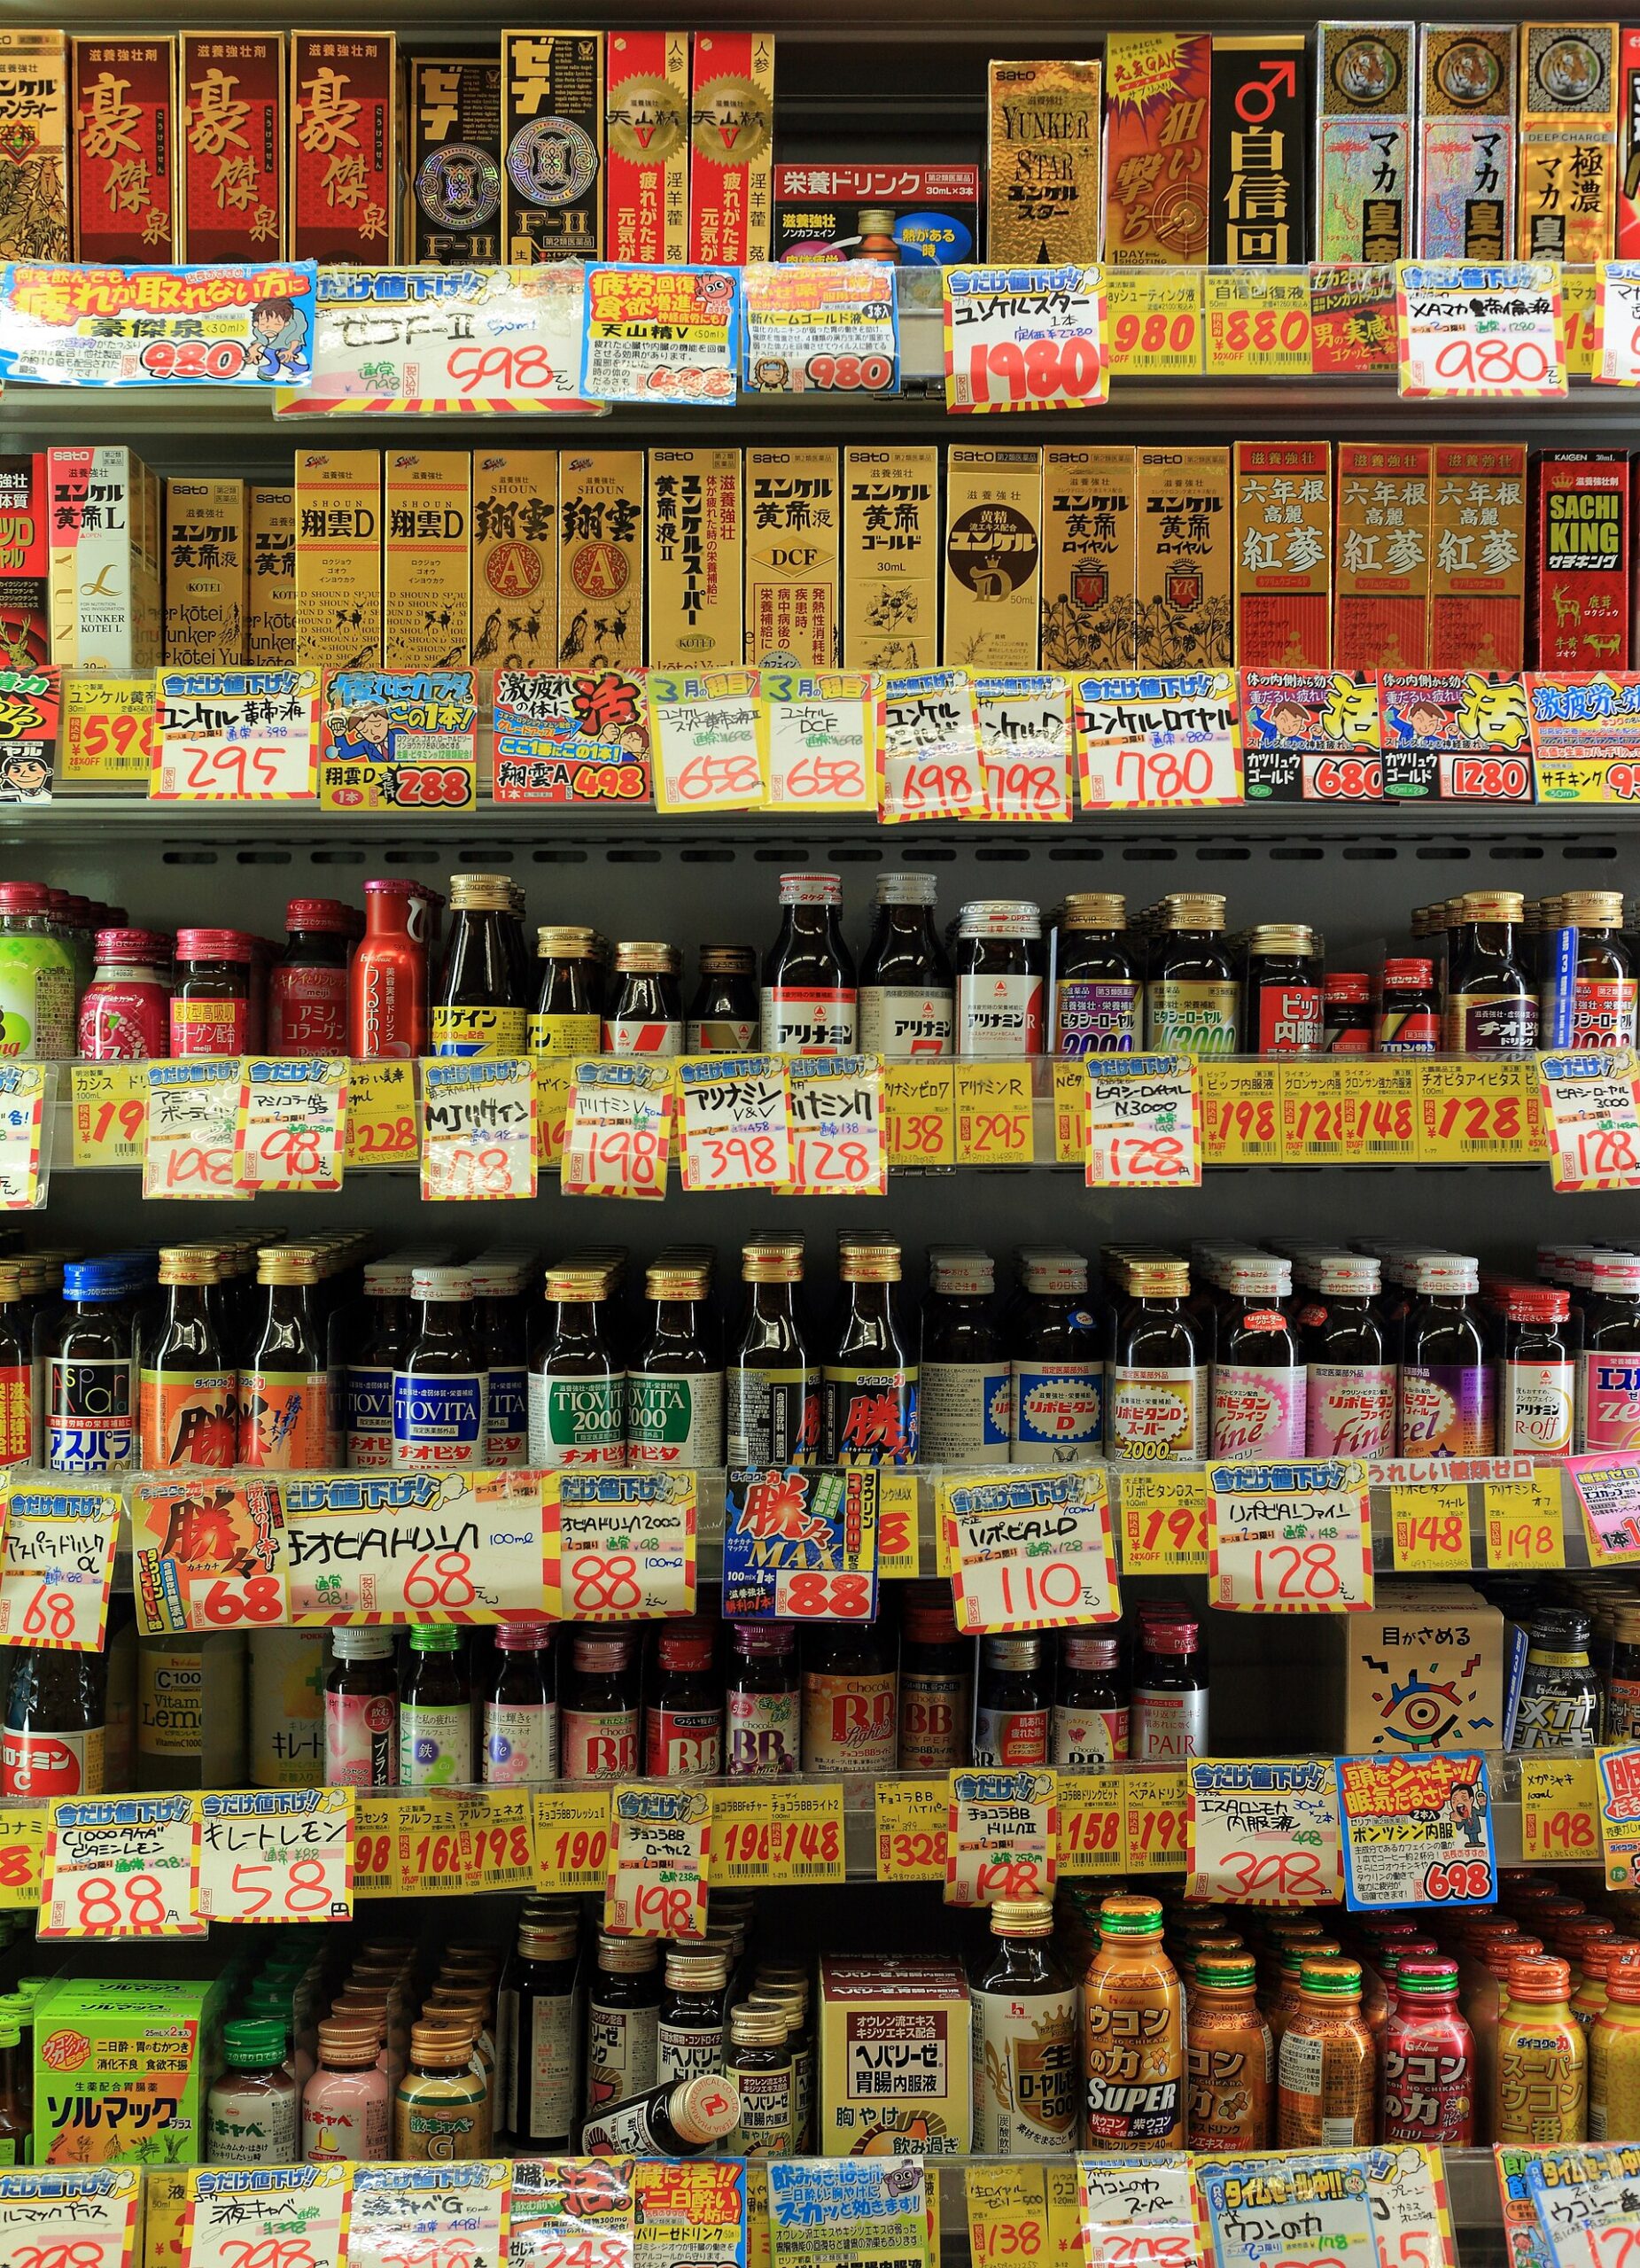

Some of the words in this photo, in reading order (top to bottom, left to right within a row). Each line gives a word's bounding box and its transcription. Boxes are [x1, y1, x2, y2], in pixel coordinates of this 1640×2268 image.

[89, 49, 158, 62] 滋養強壮剤
[198, 44, 267, 58] 滋養強壮剤
[309, 43, 377, 58] 滋養強壮剤
[511, 38, 553, 114] ゼナ
[996, 71, 1036, 82] sato
[421, 66, 462, 140] ゼナ
[1002, 105, 1089, 140] YUNKER
[1014, 150, 1073, 182] STAR
[1368, 131, 1399, 193] マカ
[1472, 131, 1501, 193] マカ
[783, 171, 920, 195] 栄養ドリンク
[1007, 185, 1079, 201] ユンケル
[1569, 146, 1605, 214] 極濃
[782, 214, 836, 228] 滋養強壮
[1018, 205, 1069, 221] スター
[782, 229, 836, 237] ノンカフェイン
[592, 274, 695, 298] 疲労回復
[1216, 286, 1304, 300] 自信回復液
[1115, 315, 1195, 352] 980
[1225, 310, 1310, 352] 880
[141, 341, 247, 378] 980
[447, 345, 553, 392] 598
[807, 356, 892, 390] 980
[971, 339, 1100, 400] 1980
[1435, 339, 1551, 382] 980
[53, 452, 89, 461] sato
[655, 452, 693, 461] sato
[752, 454, 789, 462] sato
[54, 485, 123, 501] ユンケル
[753, 478, 832, 498] ユンケル
[851, 485, 930, 501] ユンケル
[1241, 478, 1326, 505] 六年根
[1344, 481, 1428, 506] 六年根
[1437, 481, 1523, 506] 六年根
[753, 503, 834, 531] 黄帝液
[1053, 496, 1128, 511] ユンケル
[1146, 497, 1222, 512] ユンケル
[1551, 496, 1619, 519] SACHI
[302, 510, 374, 538] 翔雲D
[391, 510, 463, 538] 翔雲D
[475, 497, 554, 542] 翔雲
[561, 497, 641, 542] 翔雲
[863, 505, 919, 531] 黄帝
[171, 525, 237, 542] ユンケル
[862, 535, 921, 550] ゴールド
[950, 532, 1038, 552] ユンケル
[1061, 540, 1119, 553] ロイヤル
[1551, 524, 1619, 553] KING
[171, 545, 238, 568] 黄帝液
[680, 475, 704, 625] ユンケルスーパー
[771, 548, 818, 566] DCF
[1156, 541, 1212, 555] ロイヤル
[877, 563, 906, 571] 30mL
[81, 614, 125, 623] YUNKER
[1076, 708, 1237, 734] ユンケルロイヤル
[183, 746, 286, 795] 295
[398, 767, 468, 800] 288
[574, 765, 642, 797] 498
[679, 756, 759, 797] 658
[787, 757, 865, 797] 658
[1117, 750, 1212, 796] 780
[1453, 761, 1526, 795] 1280
[903, 765, 972, 809] 698
[987, 764, 1056, 812] 798
[299, 1006, 336, 1021] アミノ
[968, 1014, 1023, 1028] アリナミン
[1061, 1013, 1134, 1029] ビタシーローヤル
[1153, 1010, 1221, 1024] ビタシーローヤル
[287, 1023, 346, 1038] コラーゲン
[778, 1023, 851, 1045] アリナミン
[895, 1020, 951, 1037] アリナミン
[1500, 1037, 1533, 1046] ドリンク
[1207, 1078, 1274, 1091] ピップ内服液
[1345, 1077, 1412, 1089] グロンサン強力内服液
[1421, 1072, 1521, 1086] チオビタアイビタス
[1216, 1100, 1275, 1140] 198
[1356, 1099, 1413, 1139] 148
[1439, 1097, 1521, 1139] 128
[358, 1118, 417, 1152] 228
[894, 1115, 944, 1153] 138
[975, 1115, 1029, 1150] 295
[589, 1131, 657, 1183] 198
[703, 1136, 776, 1178] 398
[800, 1139, 869, 1184] 128
[1111, 1137, 1185, 1176] 128
[1580, 1130, 1636, 1176] 128
[1316, 1368, 1364, 1378] 指定医薬部外品
[396, 1398, 477, 1420] TIOVITA
[1030, 1400, 1096, 1414] リポビタン
[1116, 1409, 1180, 1422] リポビタンD
[1329, 1396, 1395, 1409] リポビタン
[1516, 1403, 1559, 1416] アリナミン
[10, 1382, 26, 1454] 滋養強壮
[1055, 1418, 1075, 1431] D
[1126, 1423, 1165, 1435] スーパー
[51, 1431, 130, 1454] アスパラ
[398, 1444, 471, 1461] チオビタ
[1409, 1517, 1462, 1551] 148
[1508, 1526, 1553, 1558] 198
[744, 1541, 841, 1570] MAX
[404, 1552, 476, 1608] 68
[571, 1555, 641, 1611] 88
[1254, 1543, 1342, 1599] 128
[204, 1579, 283, 1624] 68
[788, 1573, 869, 1617] 88
[1001, 1563, 1082, 1613] 110
[25, 1584, 76, 1638] 68
[1382, 1626, 1471, 1646] 目がさめる
[905, 1704, 952, 1734] BB
[1520, 1697, 1594, 1723] メガ
[734, 1729, 784, 1763] BB
[1148, 1736, 1196, 1754] PAIR
[772, 1801, 838, 1812] チョコラBBライト2
[206, 1822, 346, 1850] キレートレモン
[783, 1821, 839, 1860] 148
[1068, 1811, 1118, 1851] 158
[1353, 1825, 1453, 1842] ポンツシン内服
[1543, 1812, 1595, 1848] 198
[472, 1825, 528, 1869] 198
[556, 1831, 606, 1869] 190
[1218, 1851, 1326, 1895] 398
[1426, 1866, 1490, 1897] 698
[77, 1875, 167, 1925] 88
[232, 1860, 332, 1915] 58
[635, 1884, 691, 1930] 198
[857, 2016, 935, 2026] オウレン流エキス
[1091, 2006, 1169, 2033] ウコン
[856, 2028, 936, 2039] キジツエキス配合
[97, 2059, 139, 2070] 消化不良
[146, 2059, 189, 2070] 食欲不振
[855, 2043, 939, 2069] ヘパリーゼ
[1091, 2047, 1139, 2080] の力
[75, 2081, 159, 2092] 生薬配合胃腸薬
[856, 2072, 937, 2093] 胃腸内服液
[1087, 2079, 1177, 2112] SUPER
[743, 2093, 788, 2109] ヘパリーゼ
[1504, 2082, 1583, 2113] ウコン
[47, 2096, 177, 2130] ソルマック
[743, 2112, 788, 2126] 胃腸内服液
[836, 2108, 898, 2125] 胸やけ
[1391, 2127, 1457, 2140] カロリーオフ
[646, 2191, 737, 2209] 二日酔い
